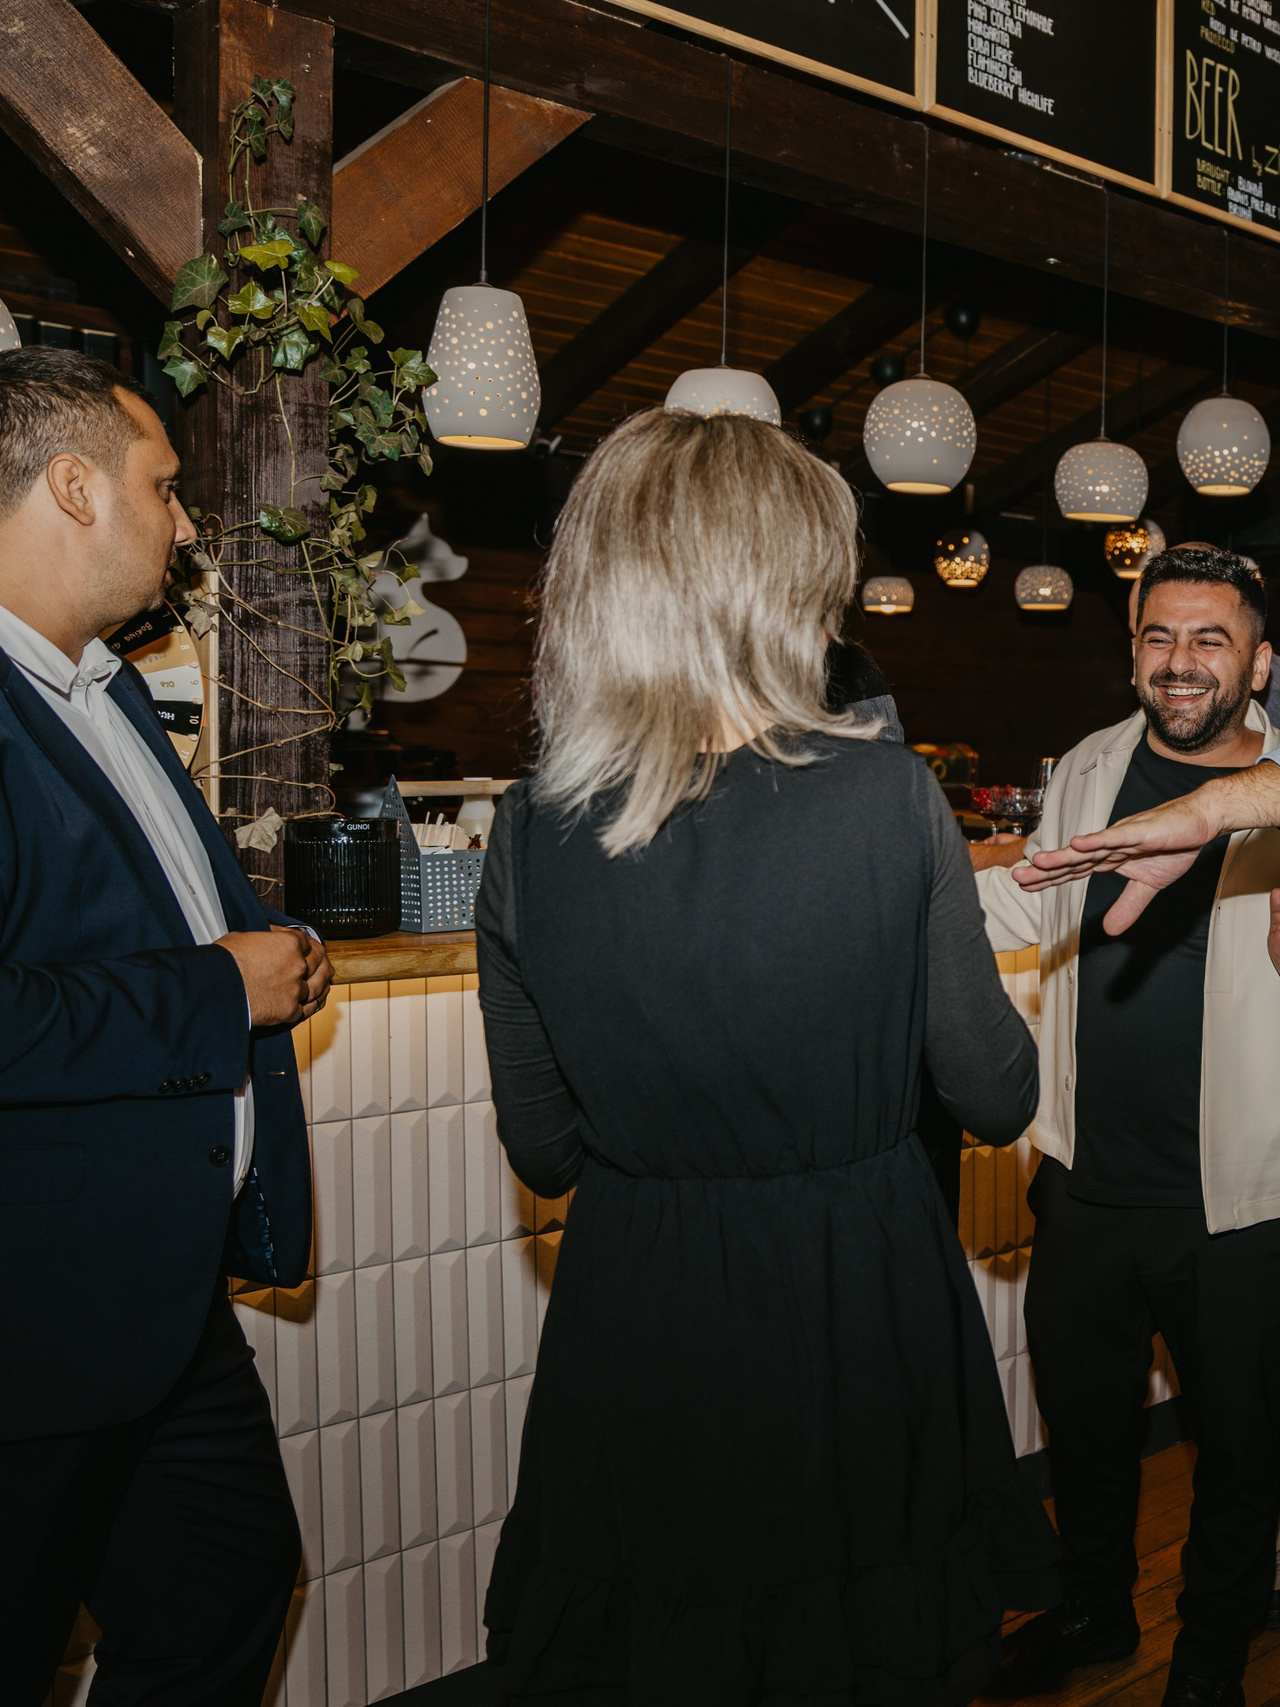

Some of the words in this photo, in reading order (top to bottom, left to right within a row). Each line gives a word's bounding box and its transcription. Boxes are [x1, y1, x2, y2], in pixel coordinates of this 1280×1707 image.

[967, 16, 1010, 48] MARGARITA
[990, 9, 1022, 39] COLADA
[1013, 4, 1055, 36] LEMONADE
[967, 32, 990, 57] CUBA
[991, 42, 1014, 67] LIBRE
[967, 50, 1008, 81] FLAMINGO
[1009, 66, 1023, 87] GIN
[967, 66, 1015, 100] BLUEBERRY
[1017, 86, 1055, 116] HIGHLIFE
[1185, 48, 1243, 161] BEER
[189, 715, 199, 725] 10
[346, 823, 370, 831] GUNOI
